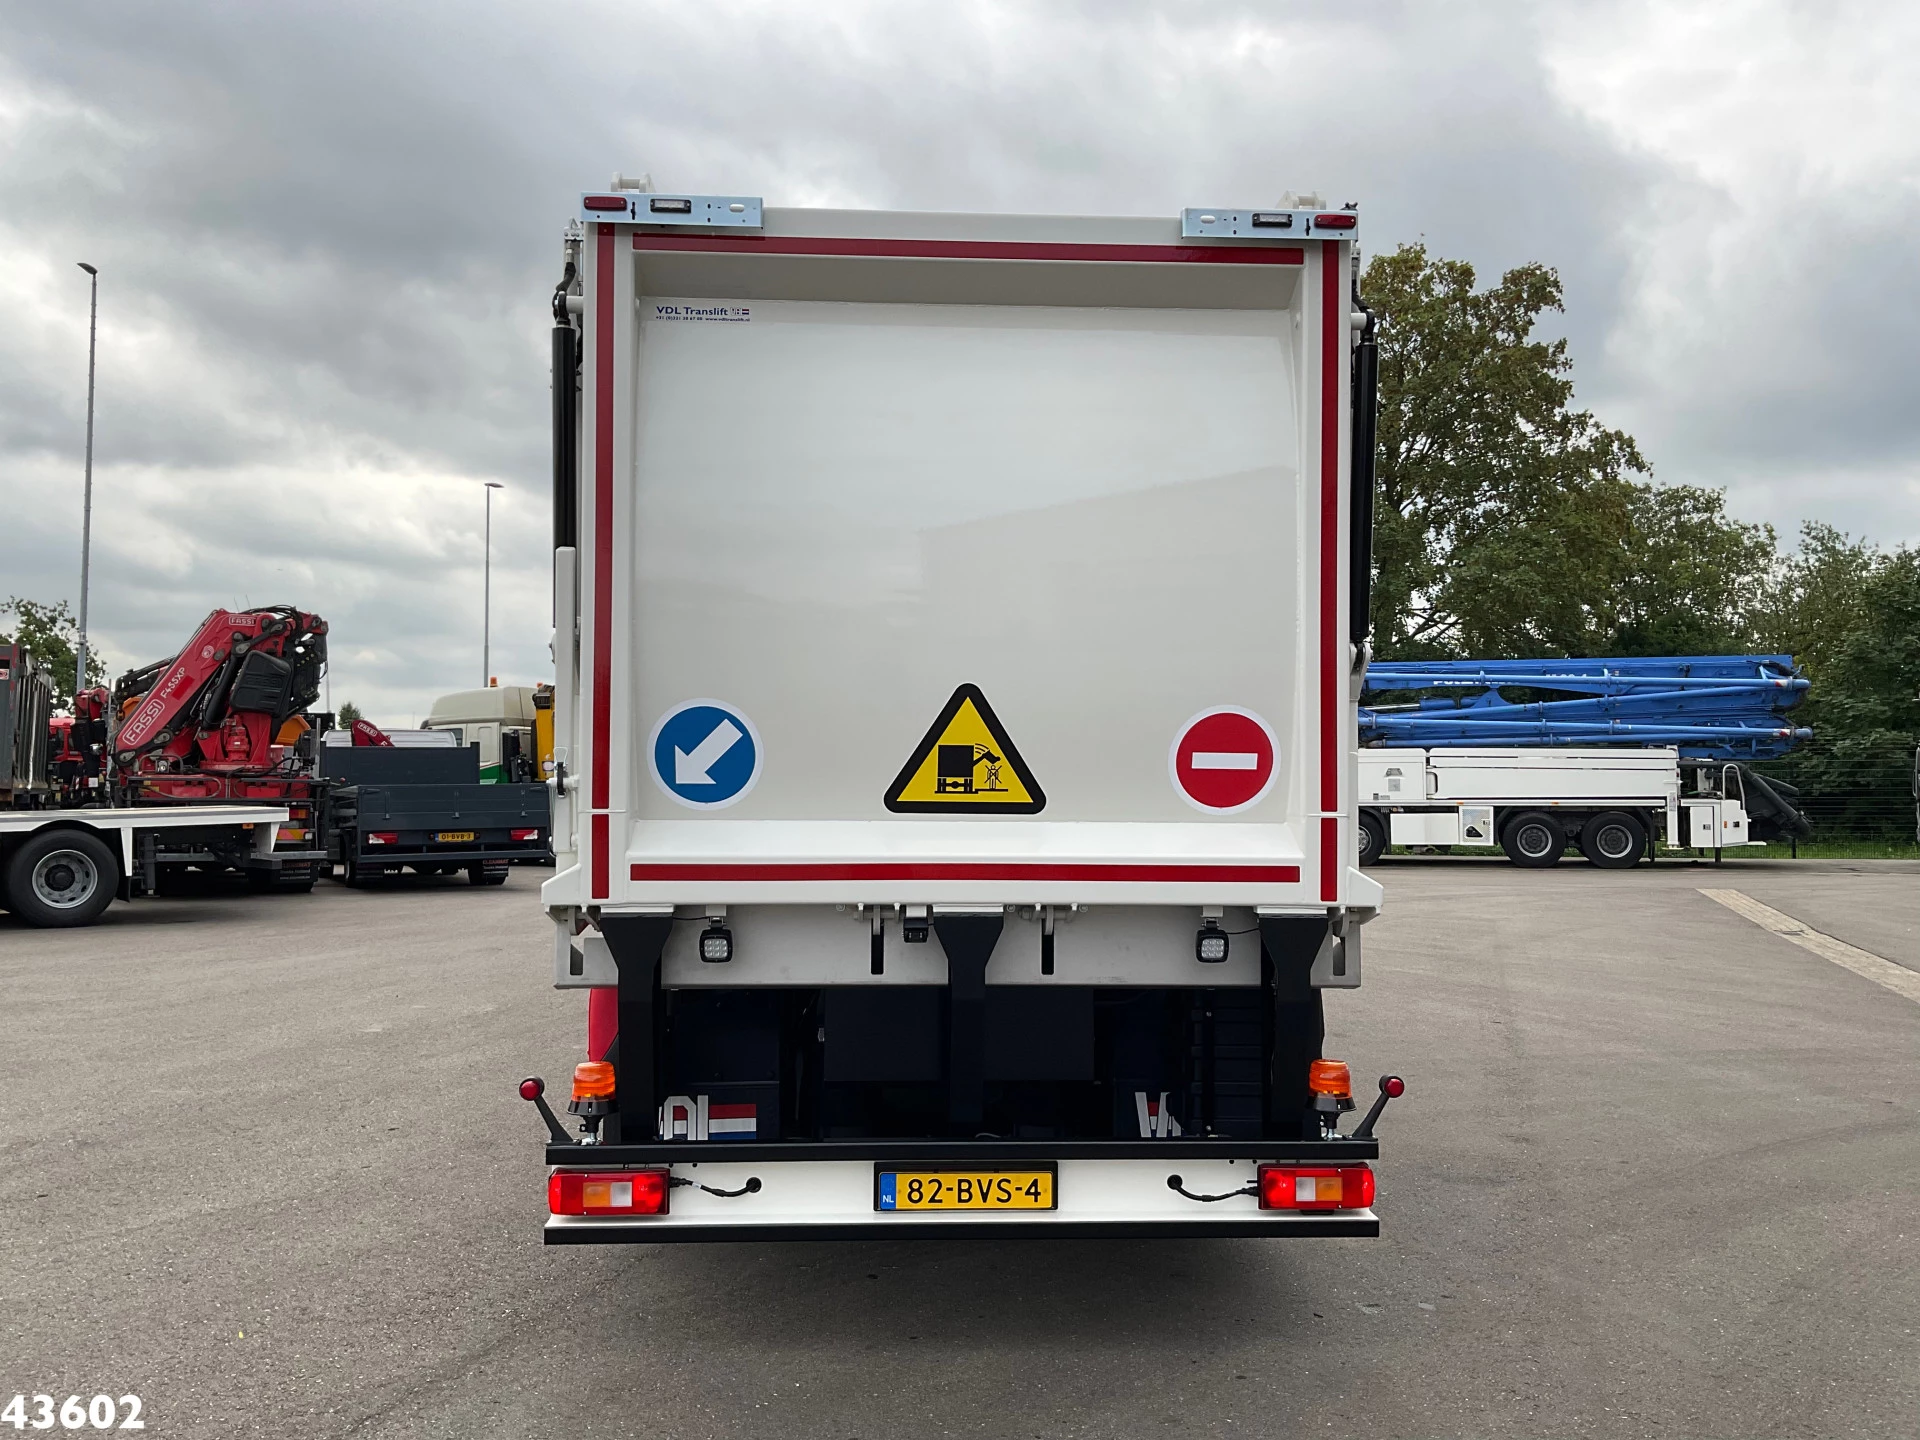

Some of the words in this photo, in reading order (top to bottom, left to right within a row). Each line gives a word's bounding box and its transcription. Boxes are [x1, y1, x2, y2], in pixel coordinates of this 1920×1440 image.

[656, 306, 681, 315] VDL
[683, 306, 728, 316] Translift
[230, 617, 255, 625] FASSI
[125, 702, 162, 742] FASSI
[882, 1195, 895, 1203] NL
[907, 1178, 1042, 1204] 82-BVS-4
